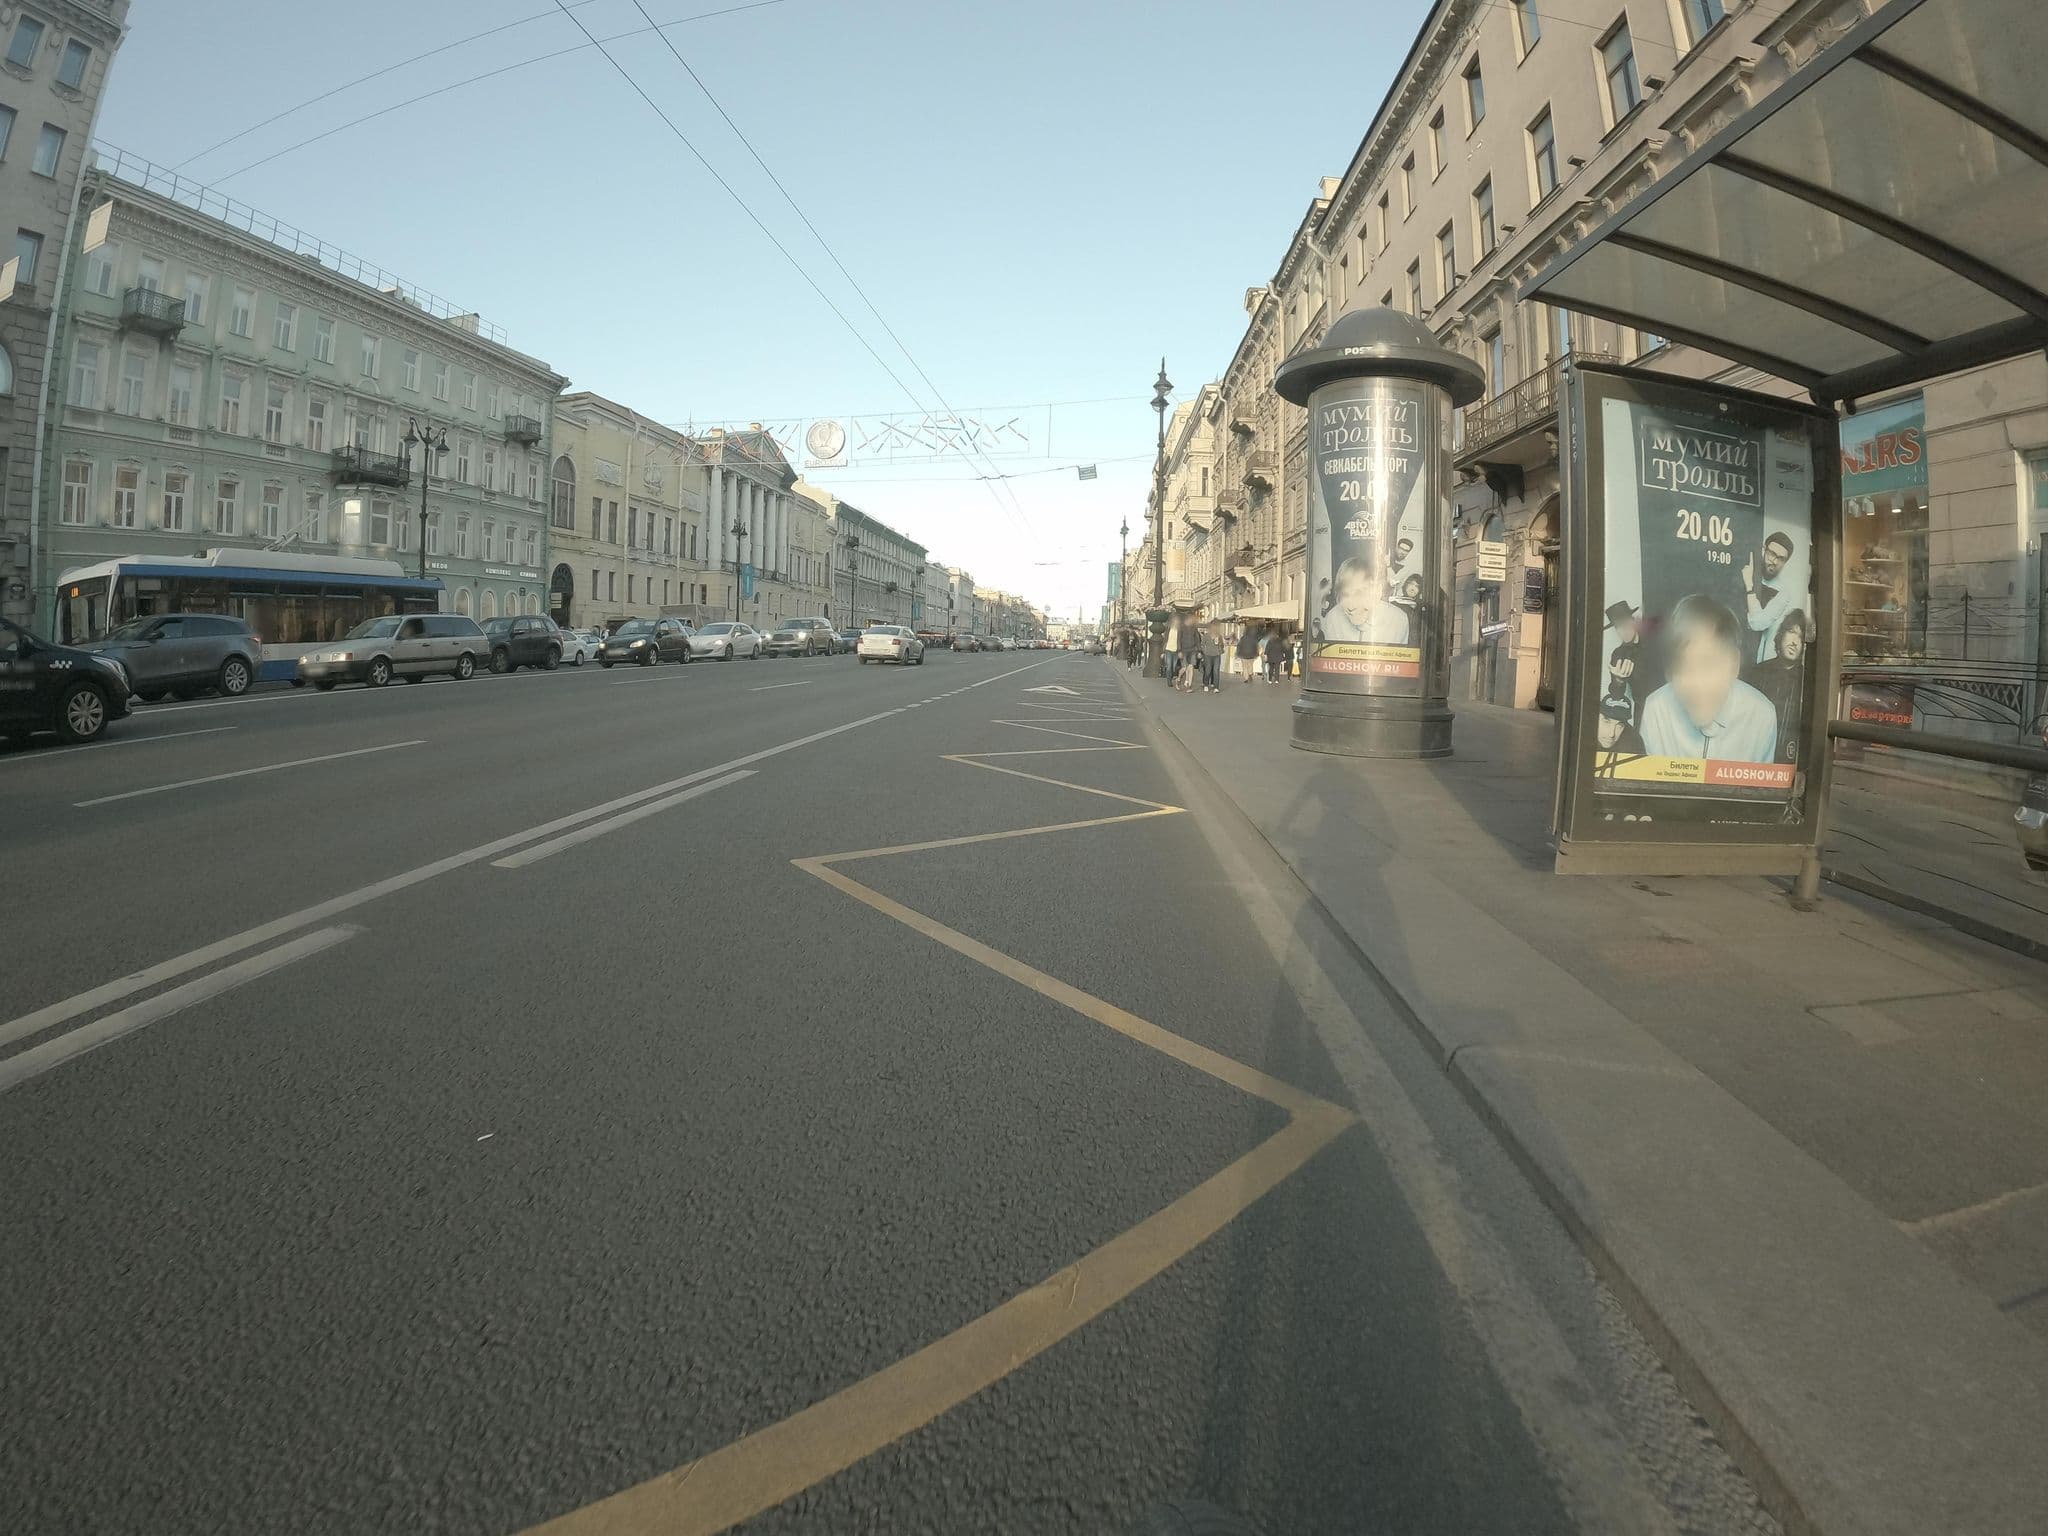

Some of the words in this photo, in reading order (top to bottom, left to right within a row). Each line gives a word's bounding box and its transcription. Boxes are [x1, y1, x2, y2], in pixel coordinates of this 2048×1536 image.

[1676, 509, 1733, 546] 20.06
[1707, 550, 1731, 565] 19:00
[1339, 647, 1367, 655] Билеты
[1322, 661, 1401, 673] ALLOSHOW.RU
[1670, 761, 1699, 770] Билеты
[1716, 767, 1790, 782] ALLOSHOW.RU
